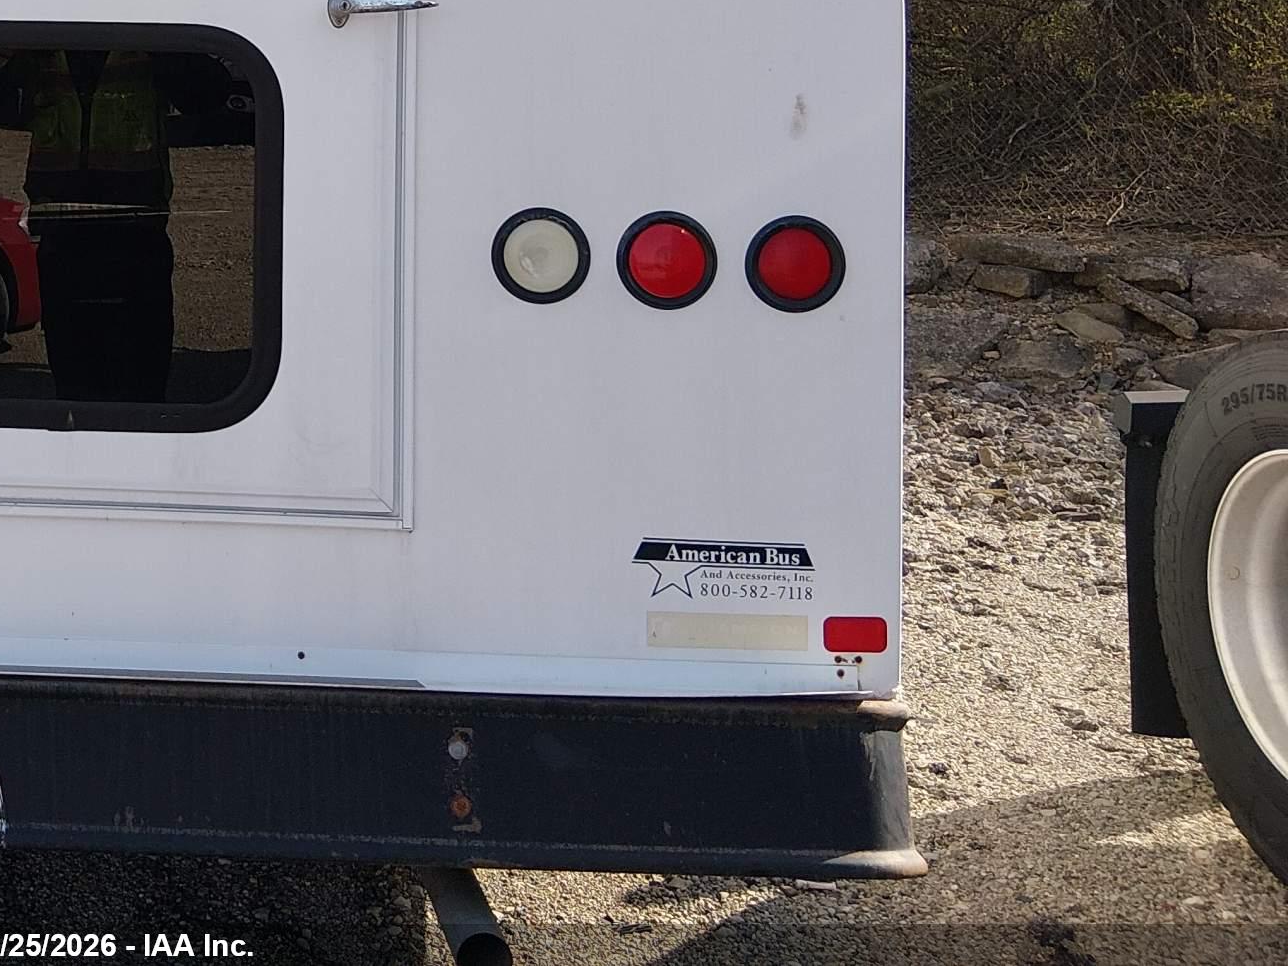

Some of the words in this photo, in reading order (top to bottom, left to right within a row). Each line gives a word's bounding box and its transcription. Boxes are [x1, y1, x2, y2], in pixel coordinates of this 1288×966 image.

[665, 544, 761, 564] American
[765, 548, 801, 566] Bus
[700, 570, 723, 580] And
[726, 571, 790, 583] Accessories,
[793, 573, 814, 583] Inc.
[700, 584, 813, 600] 800-582-7118
